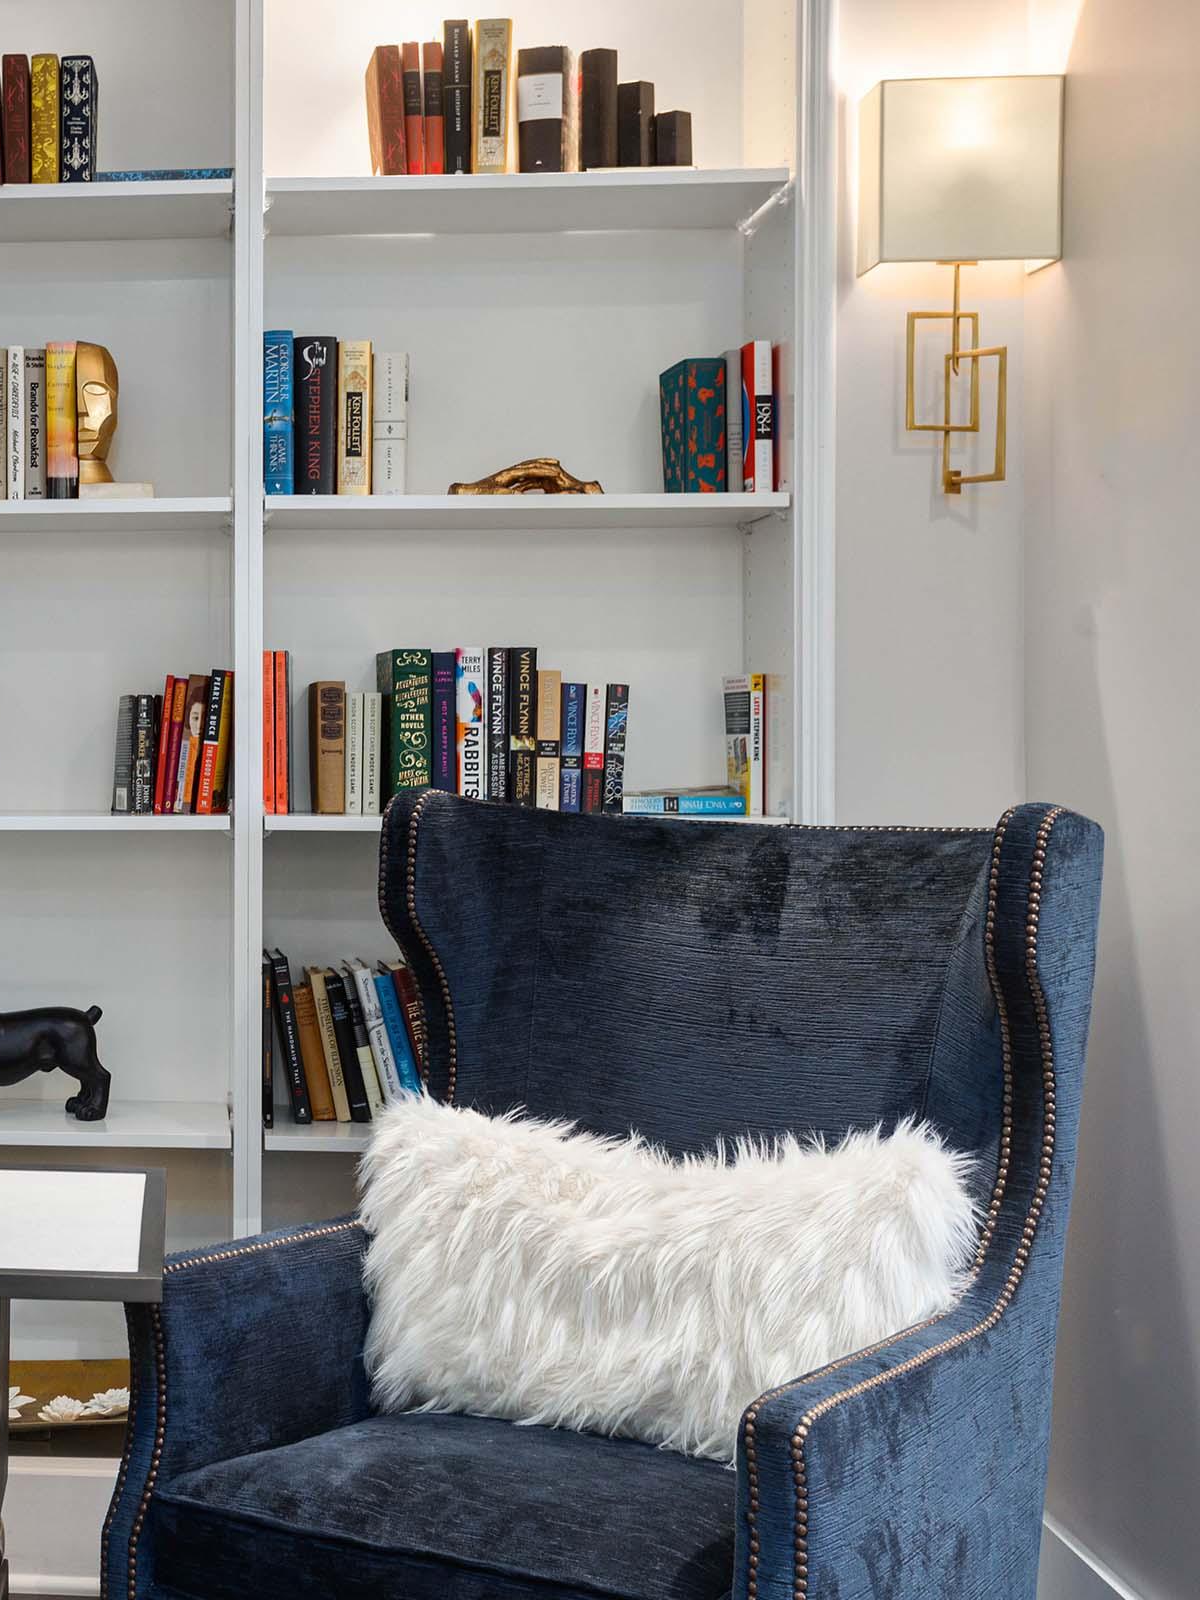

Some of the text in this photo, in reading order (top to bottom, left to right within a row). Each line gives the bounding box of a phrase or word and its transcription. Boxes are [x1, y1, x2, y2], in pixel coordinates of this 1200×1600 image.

[490, 74, 499, 131] KEN FOLLETT
[264, 344, 279, 403] MARTIN
[279, 344, 290, 383] GEORGE
[30, 382, 40, 469] Brando for Breakfast
[308, 368, 321, 480] STEPHEN KING
[352, 396, 361, 453] KEN FOLLETT
[756, 402, 772, 434] 1984
[270, 434, 278, 472] THRONES
[461, 656, 481, 664] TERRY
[461, 665, 481, 673] MILES
[395, 687, 428, 702] HUCKLEBERRY
[396, 676, 428, 690] ADVENTURES
[417, 696, 428, 705] FINN
[492, 652, 502, 735] VINCE FLYNN
[519, 651, 530, 734] VINCE FLYNN
[208, 677, 221, 736] PEARL S. BUCK
[609, 702, 618, 739] FLYNN
[617, 702, 628, 739] VINCE
[567, 700, 578, 756] VINCE FLYNN
[399, 769, 415, 780] MARK
[410, 775, 428, 787] TWAIN
[464, 727, 480, 800] RABBITS
[498, 752, 506, 798] AMERICAN
[516, 753, 524, 800] MEASURES
[523, 756, 531, 796] EXTREME
[605, 758, 616, 805] TREASON
[614, 762, 623, 800] ACT OF
[136, 778, 144, 810] GRISHAM
[320, 998, 329, 1014] THE
[406, 1001, 417, 1020] THE
[323, 1015, 334, 1039] SHAPE
[330, 1051, 344, 1087] ILLUSION
